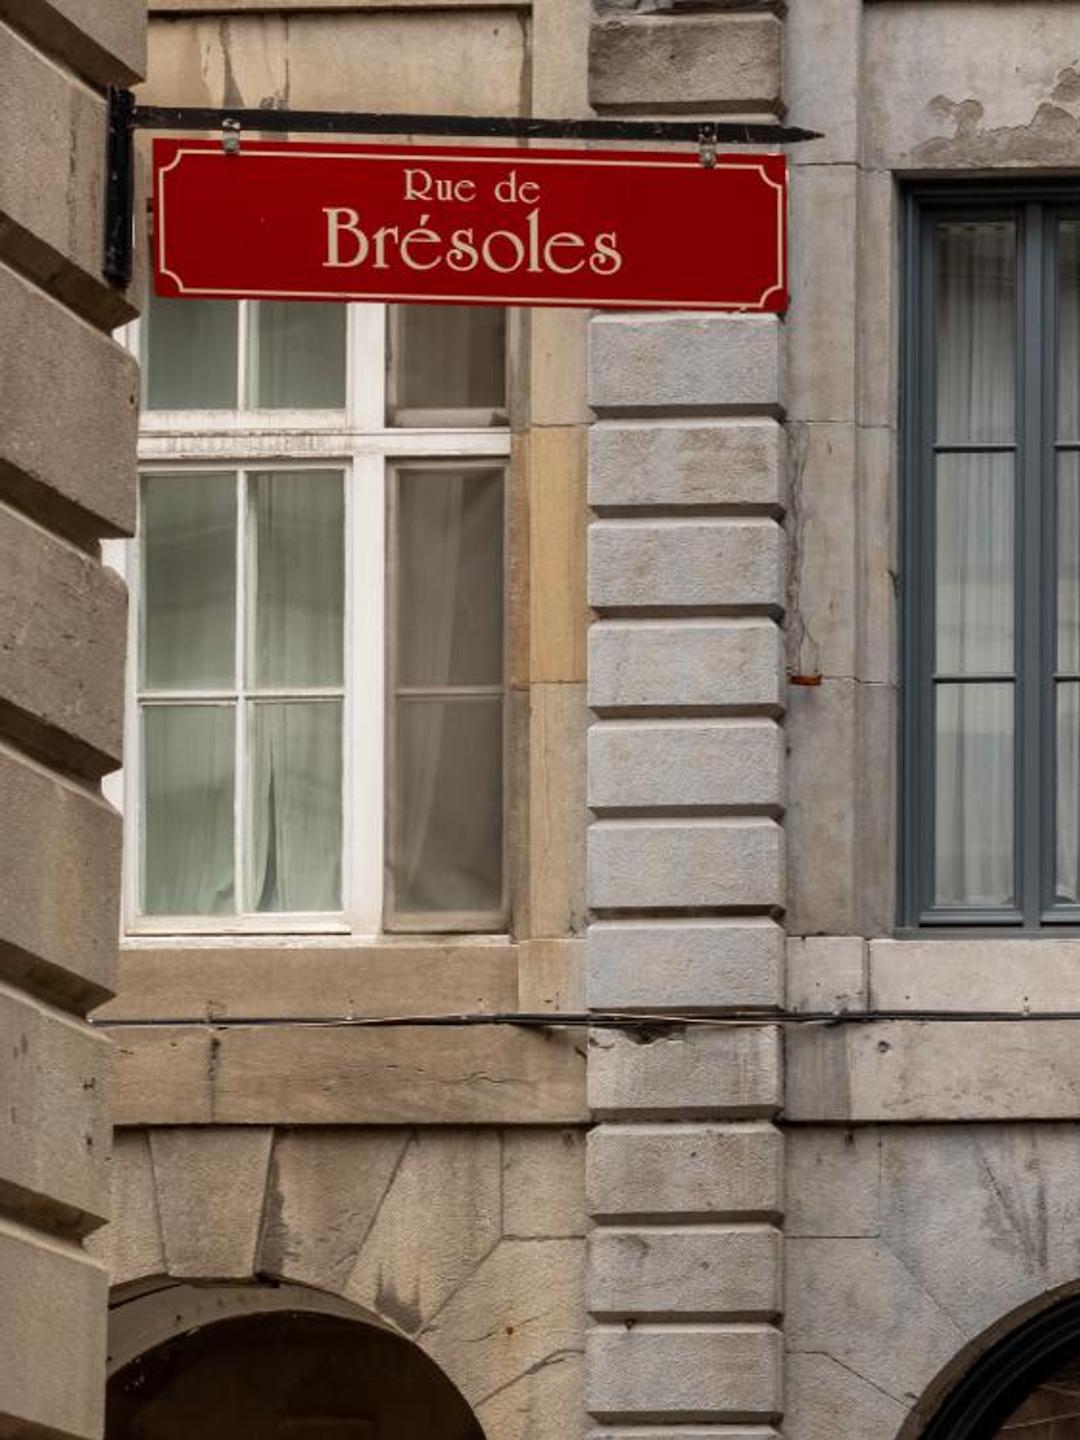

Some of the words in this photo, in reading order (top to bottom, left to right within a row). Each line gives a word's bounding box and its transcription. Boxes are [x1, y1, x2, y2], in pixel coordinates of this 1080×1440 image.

[405, 168, 475, 202] Rue
[494, 171, 539, 204] de
[322, 208, 622, 275] Brésoles
